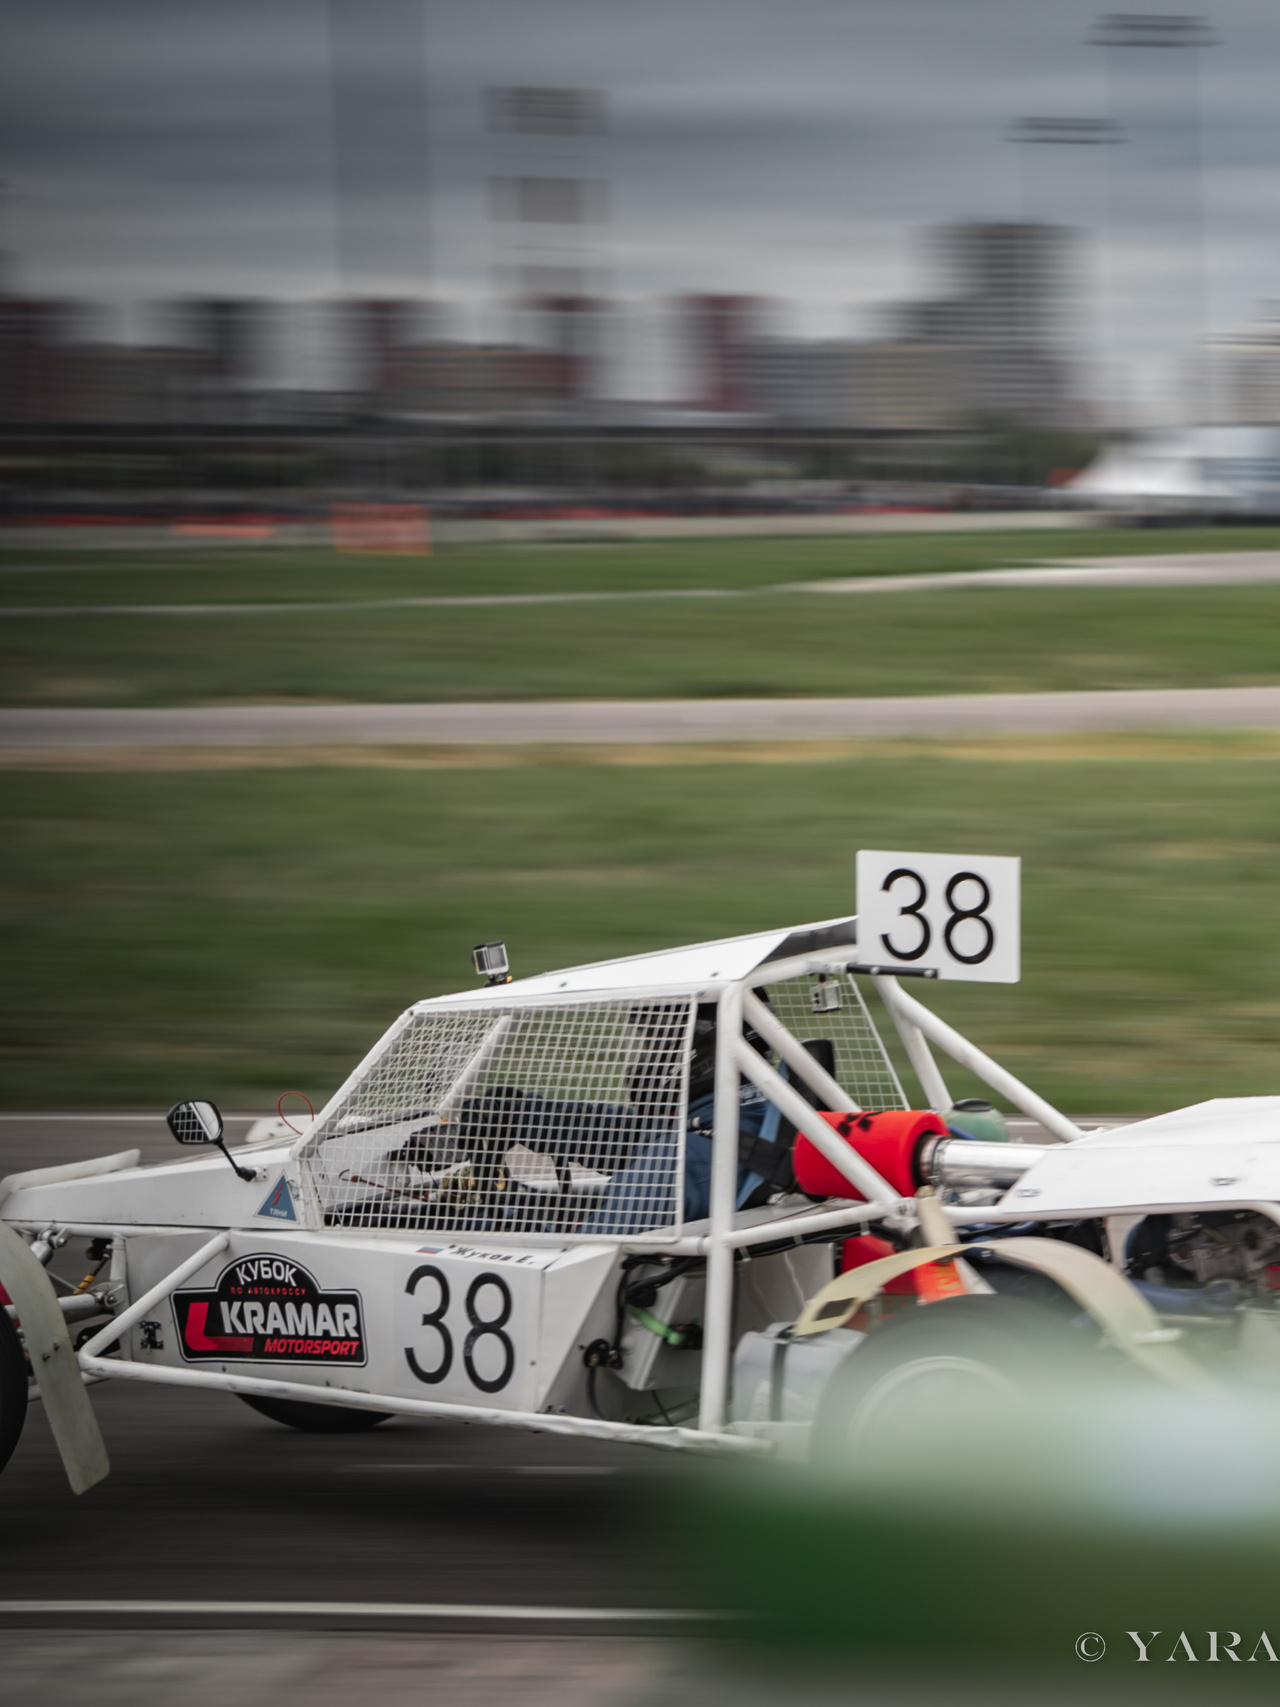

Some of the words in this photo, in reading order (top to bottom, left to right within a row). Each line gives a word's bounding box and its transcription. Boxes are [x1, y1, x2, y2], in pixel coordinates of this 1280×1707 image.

[880, 868, 994, 965] 38
[235, 1259, 297, 1287] КУБОК
[230, 1286, 243, 1295] ПО
[247, 1286, 306, 1296] АВТОКРОССУ
[219, 1300, 359, 1338] KRAMAR
[403, 1264, 515, 1394] 38
[263, 1337, 360, 1356] MOTORSPORT
